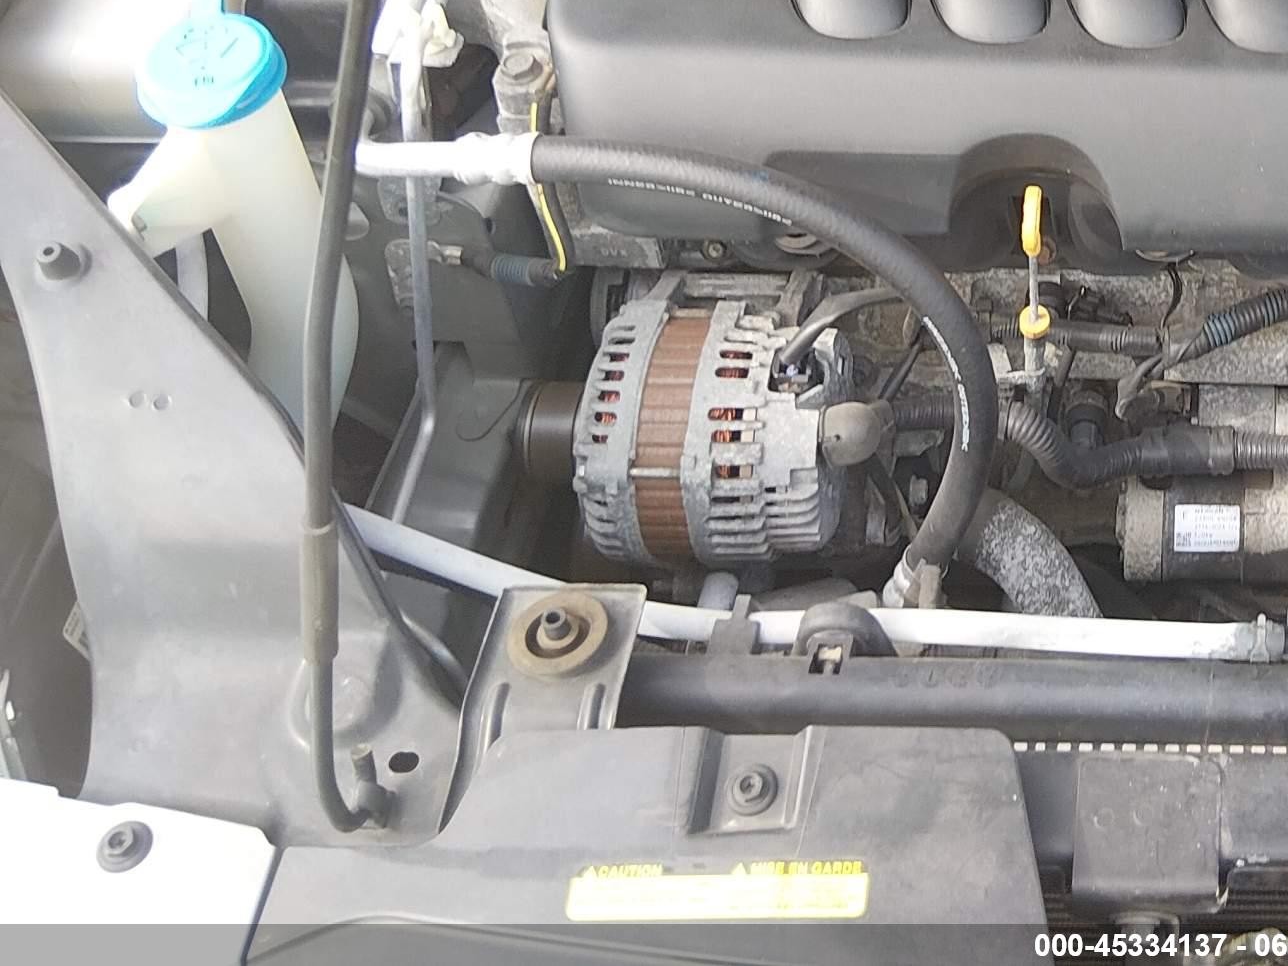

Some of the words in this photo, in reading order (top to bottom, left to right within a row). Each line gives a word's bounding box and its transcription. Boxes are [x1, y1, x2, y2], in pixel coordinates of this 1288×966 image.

[599, 863, 664, 877] CAUTION
[788, 860, 808, 874] EN
[810, 860, 863, 874] GARDE
